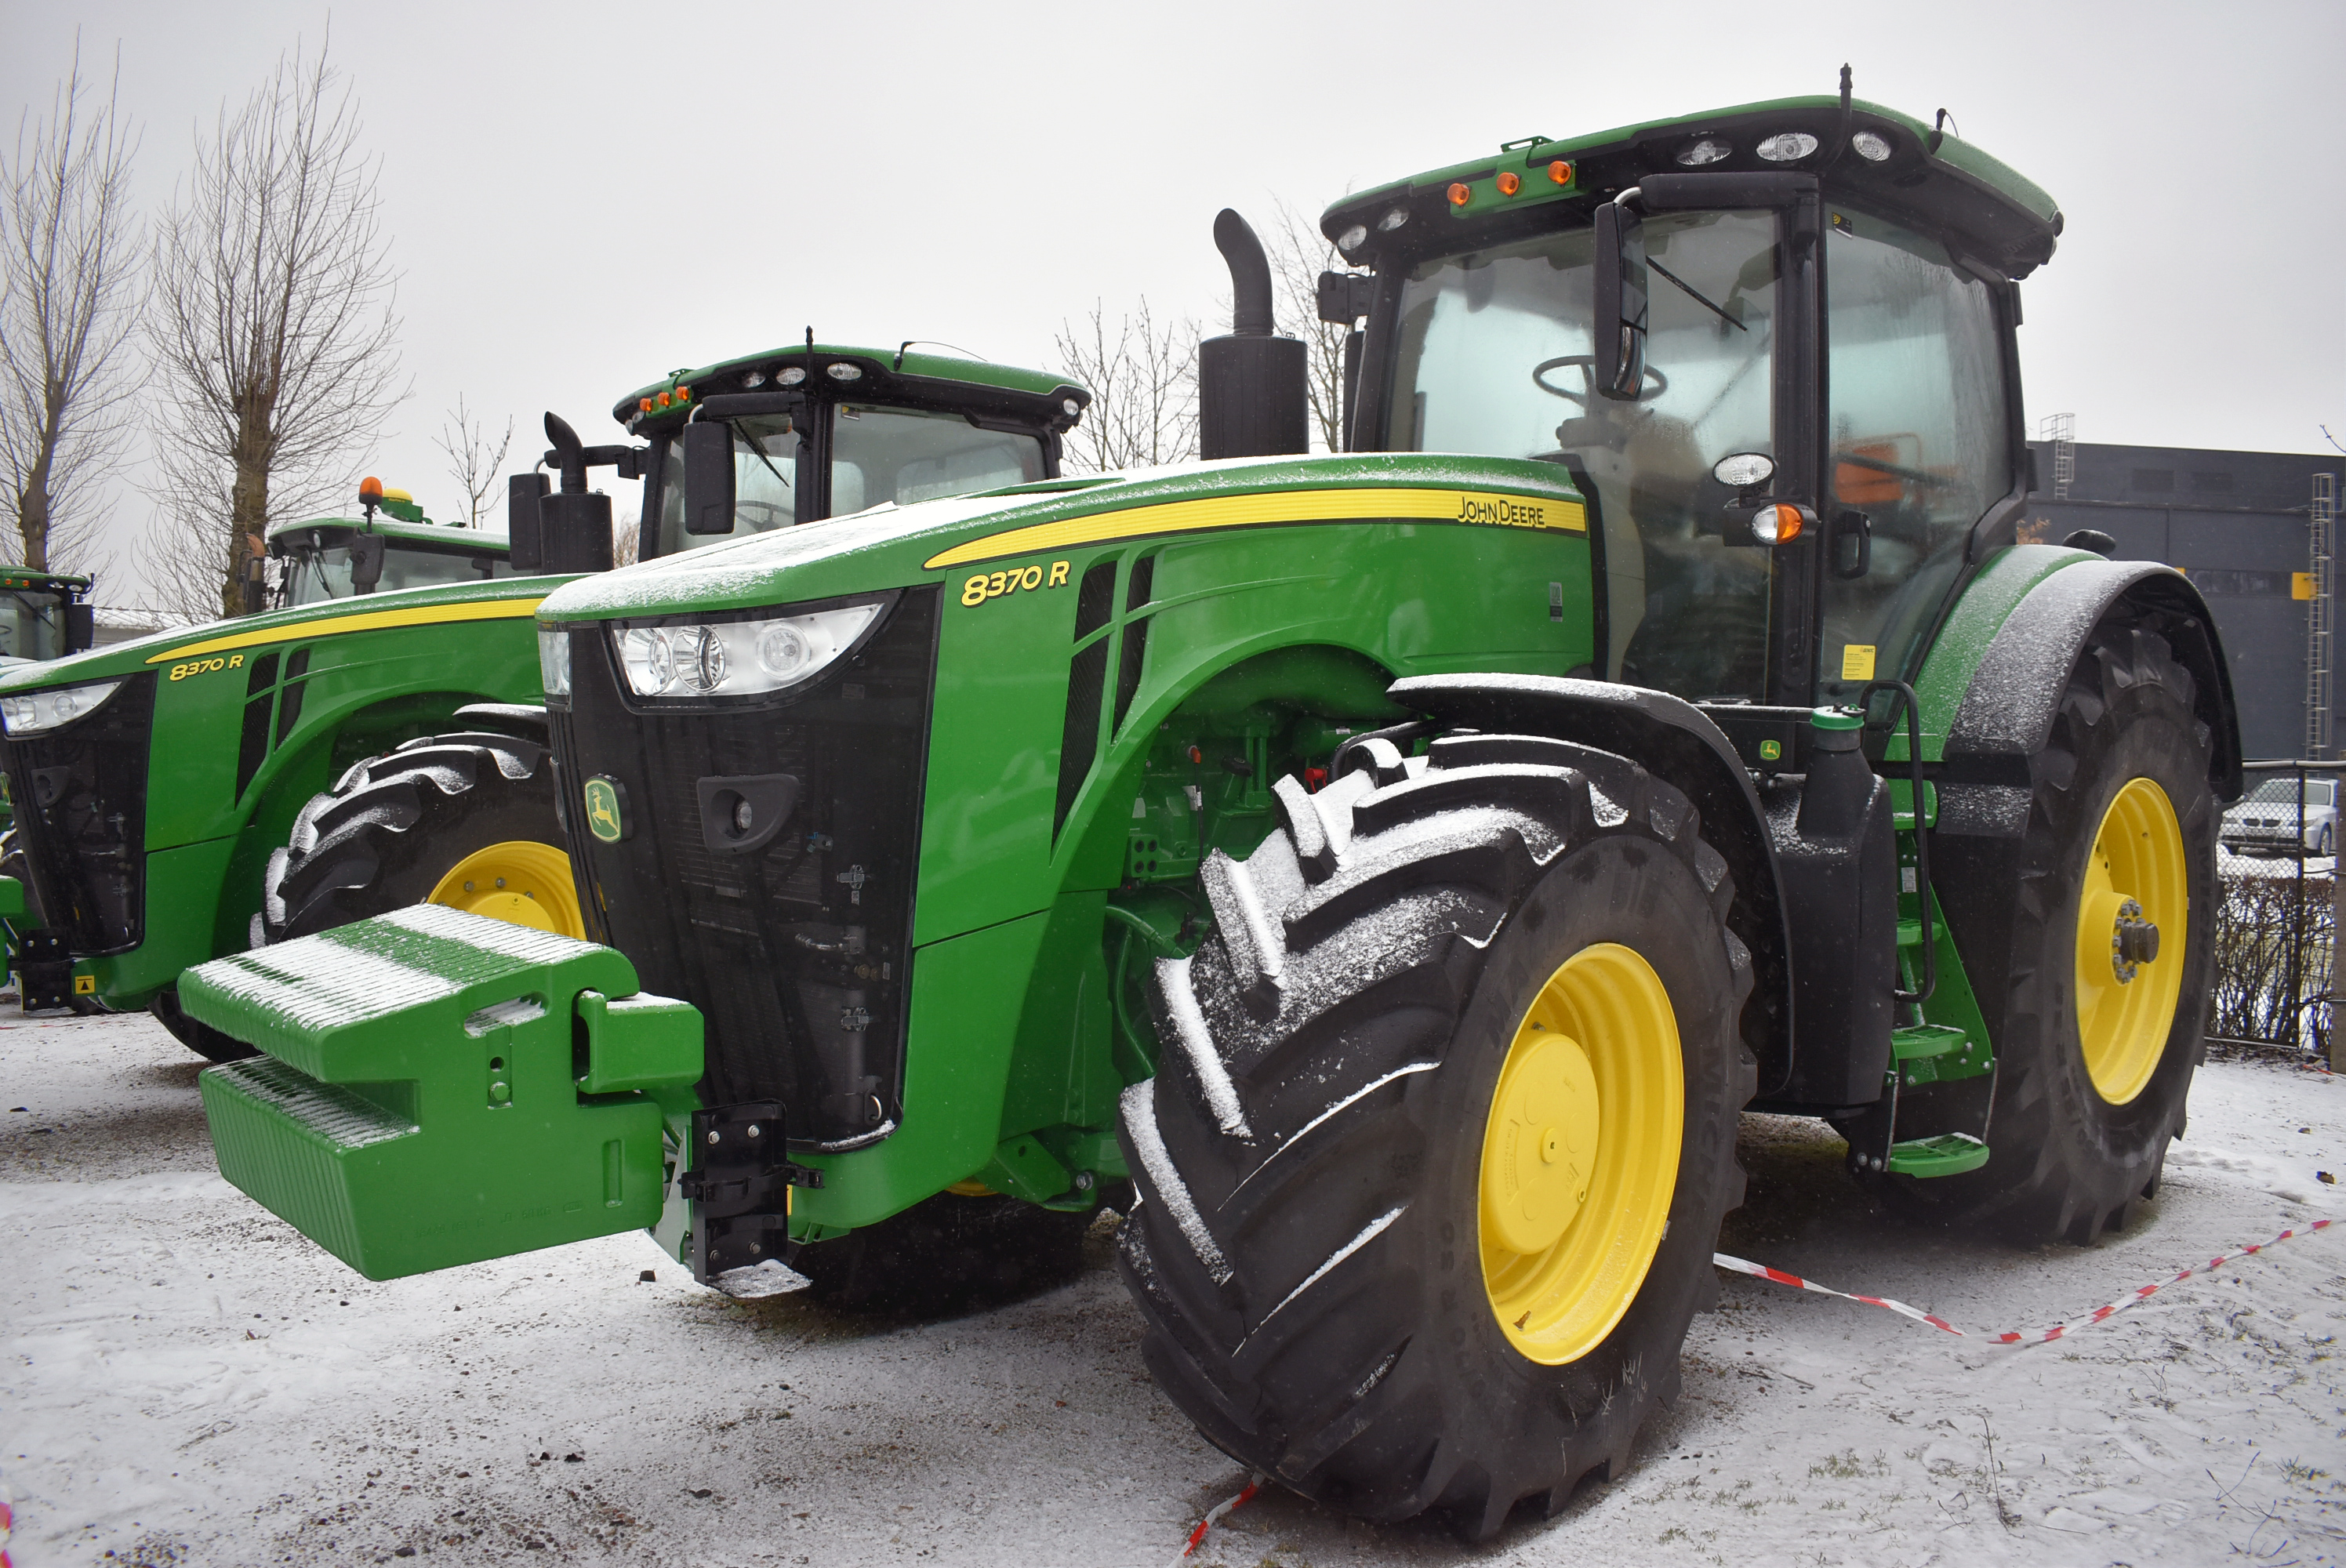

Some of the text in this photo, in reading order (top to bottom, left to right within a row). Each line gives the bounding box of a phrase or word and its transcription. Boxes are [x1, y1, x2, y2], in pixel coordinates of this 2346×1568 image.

[1458, 495, 1545, 525] JOHN DEERE
[961, 560, 1072, 608] 8370 R
[169, 654, 245, 682] 8370 R
